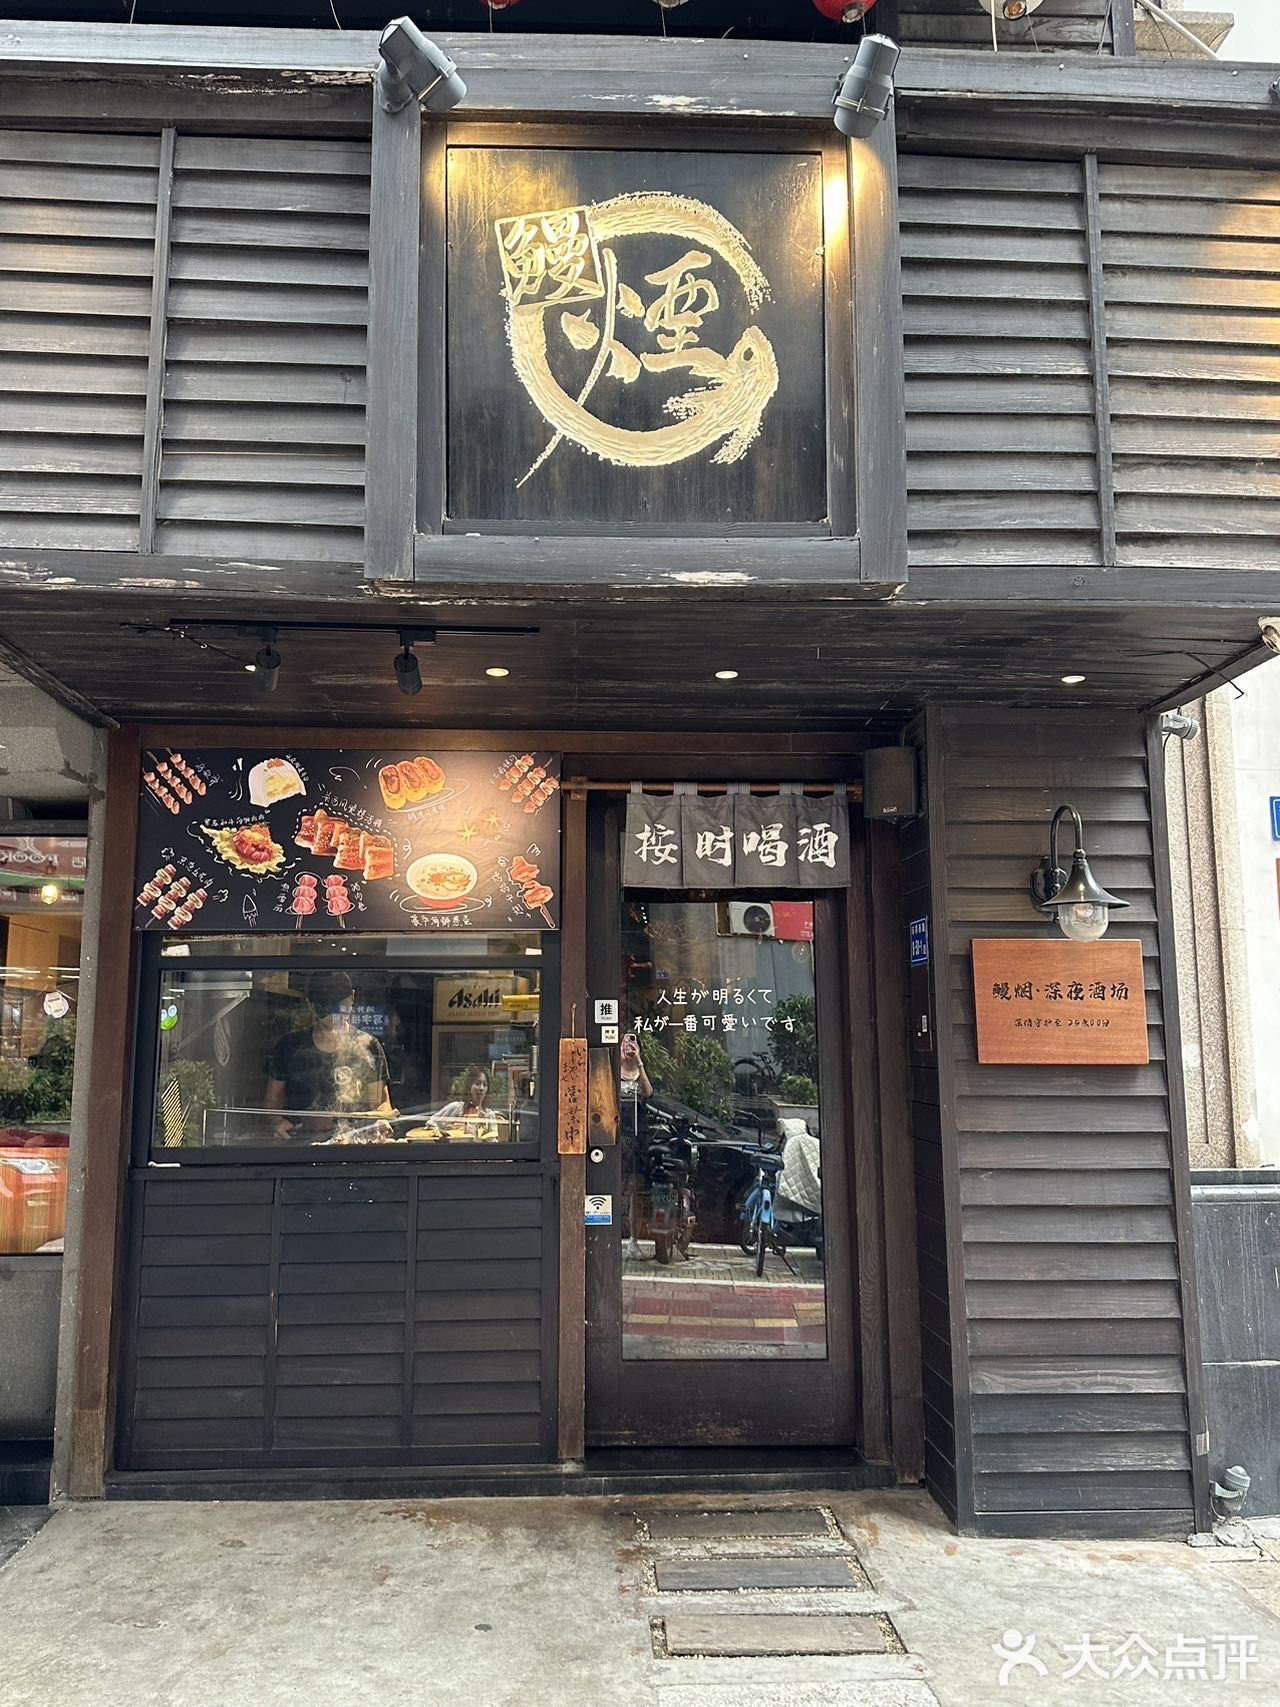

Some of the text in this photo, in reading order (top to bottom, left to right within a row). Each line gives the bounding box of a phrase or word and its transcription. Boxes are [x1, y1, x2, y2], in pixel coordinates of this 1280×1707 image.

[634, 822, 839, 868] 按时喝酒
[448, 988, 501, 1009] Asahi
[656, 988, 773, 1005] 人生が明るくて
[600, 1003, 613, 1016] 推
[633, 1014, 797, 1034] 私が一番可愛いです
